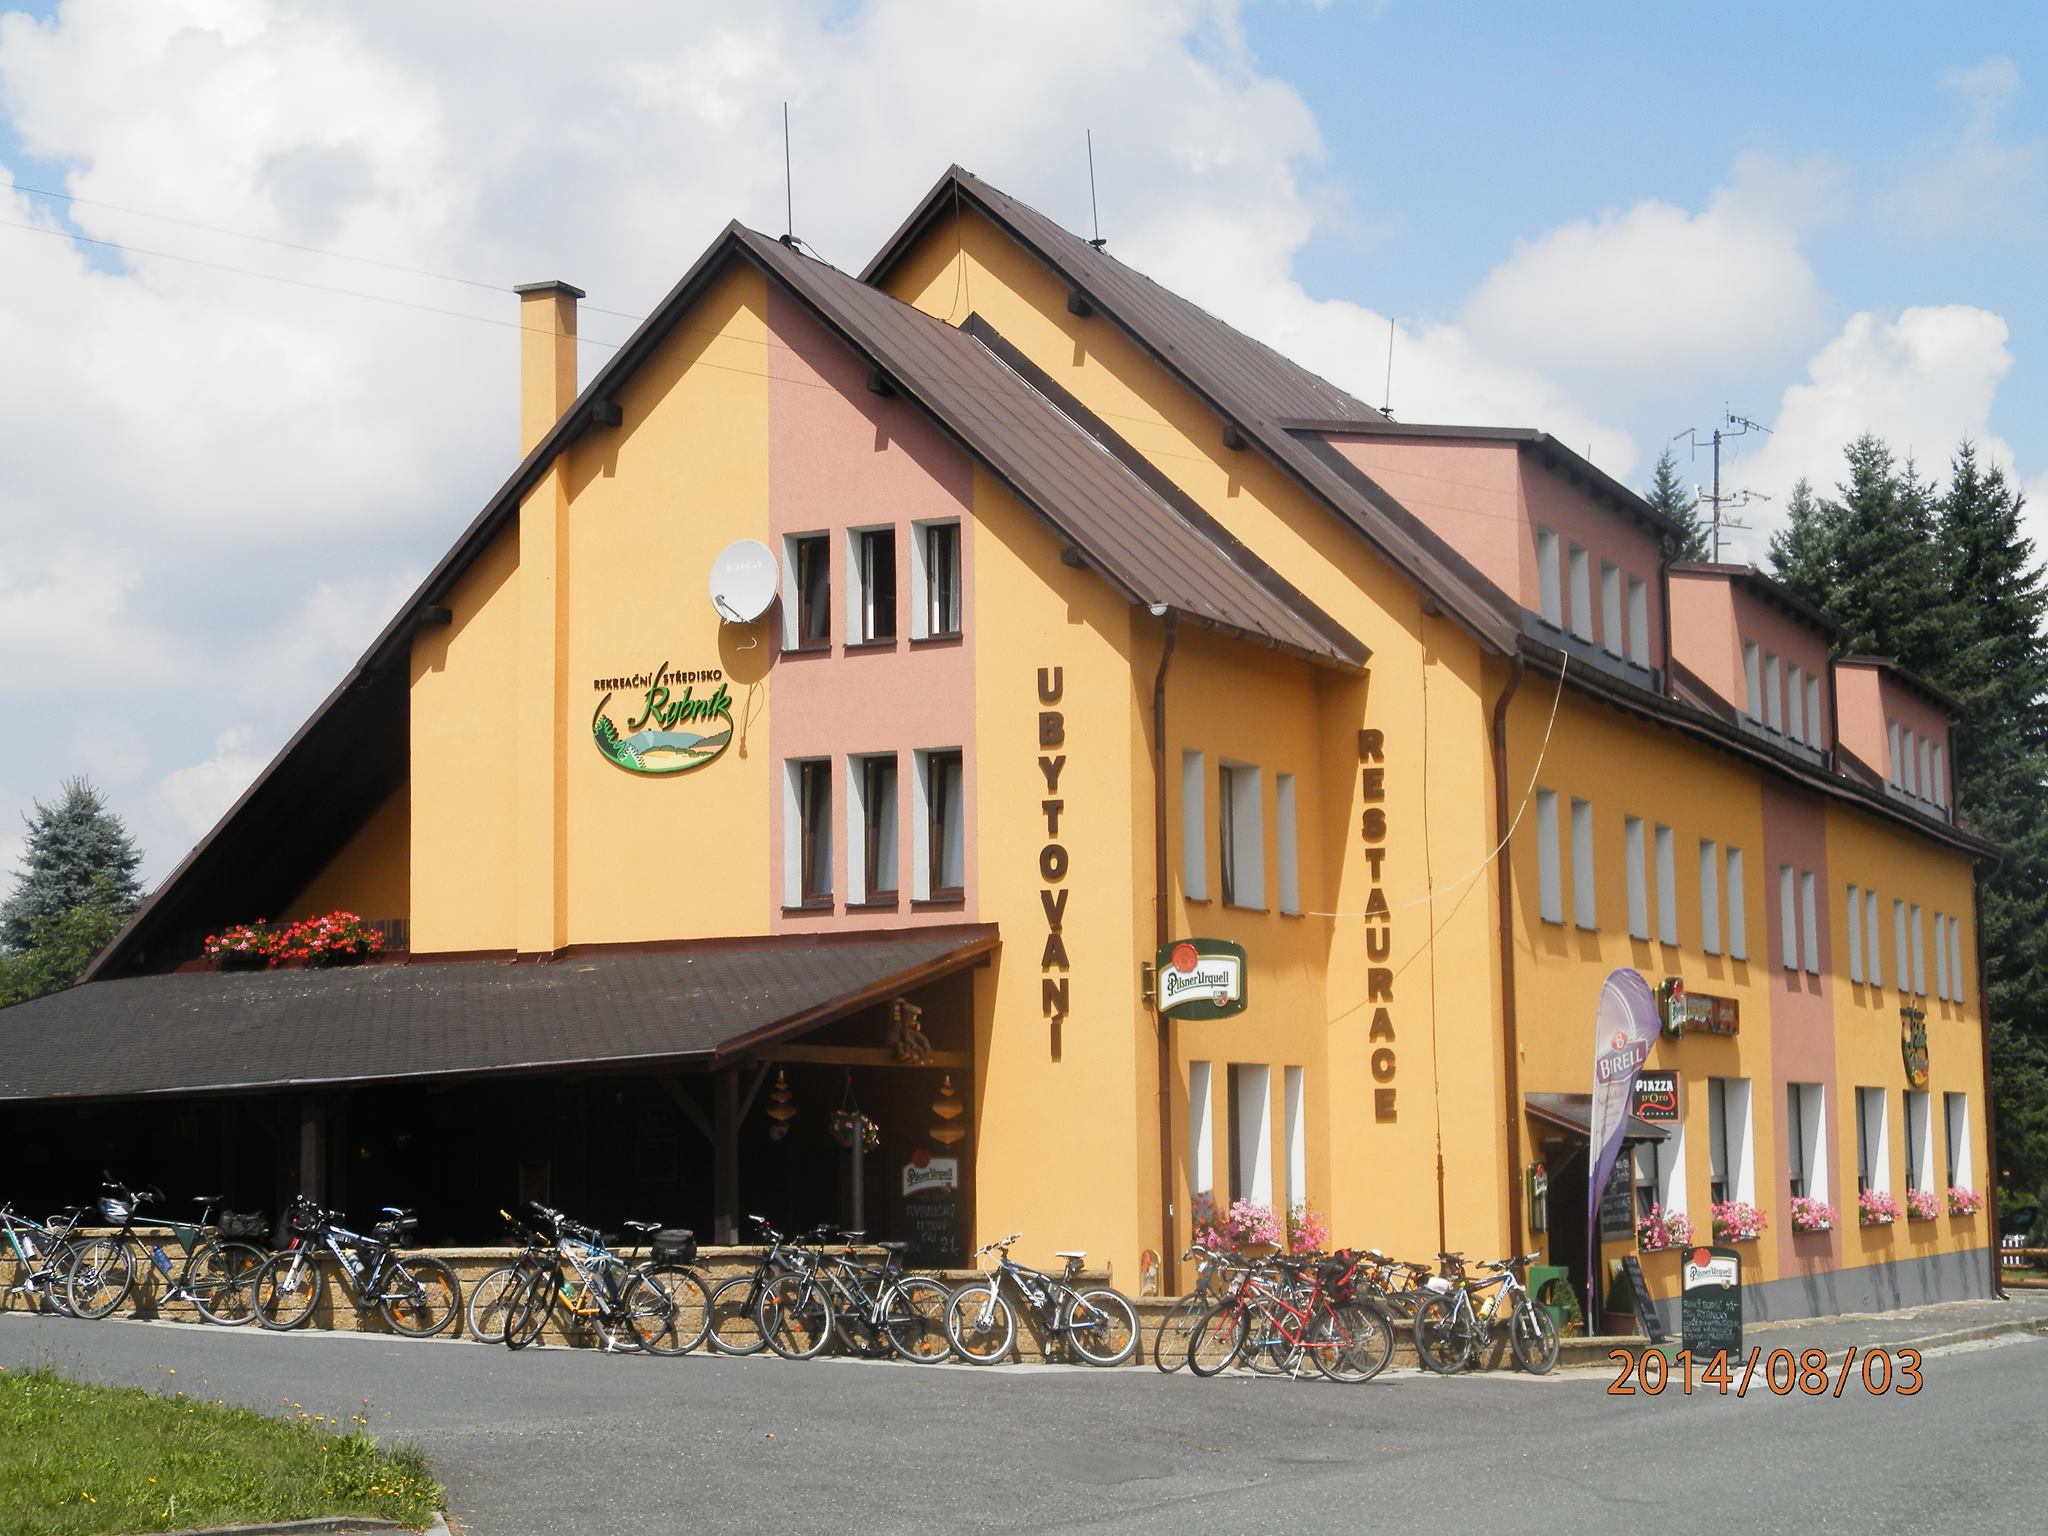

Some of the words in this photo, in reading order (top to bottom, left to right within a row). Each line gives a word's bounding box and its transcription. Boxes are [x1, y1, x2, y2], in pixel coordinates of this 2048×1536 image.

[593, 672, 653, 690] REKREAČNÍ
[663, 669, 722, 685] STŘEDISKO
[1037, 666, 1070, 1061] UBYTOVÁNÍ
[1358, 728, 1397, 1123] RESTAURACE
[1167, 972, 1198, 997] Pilsner
[1197, 970, 1229, 989] Urquell
[1600, 1047, 1643, 1080] BIRELL
[1635, 1079, 1674, 1092] PIAZZA
